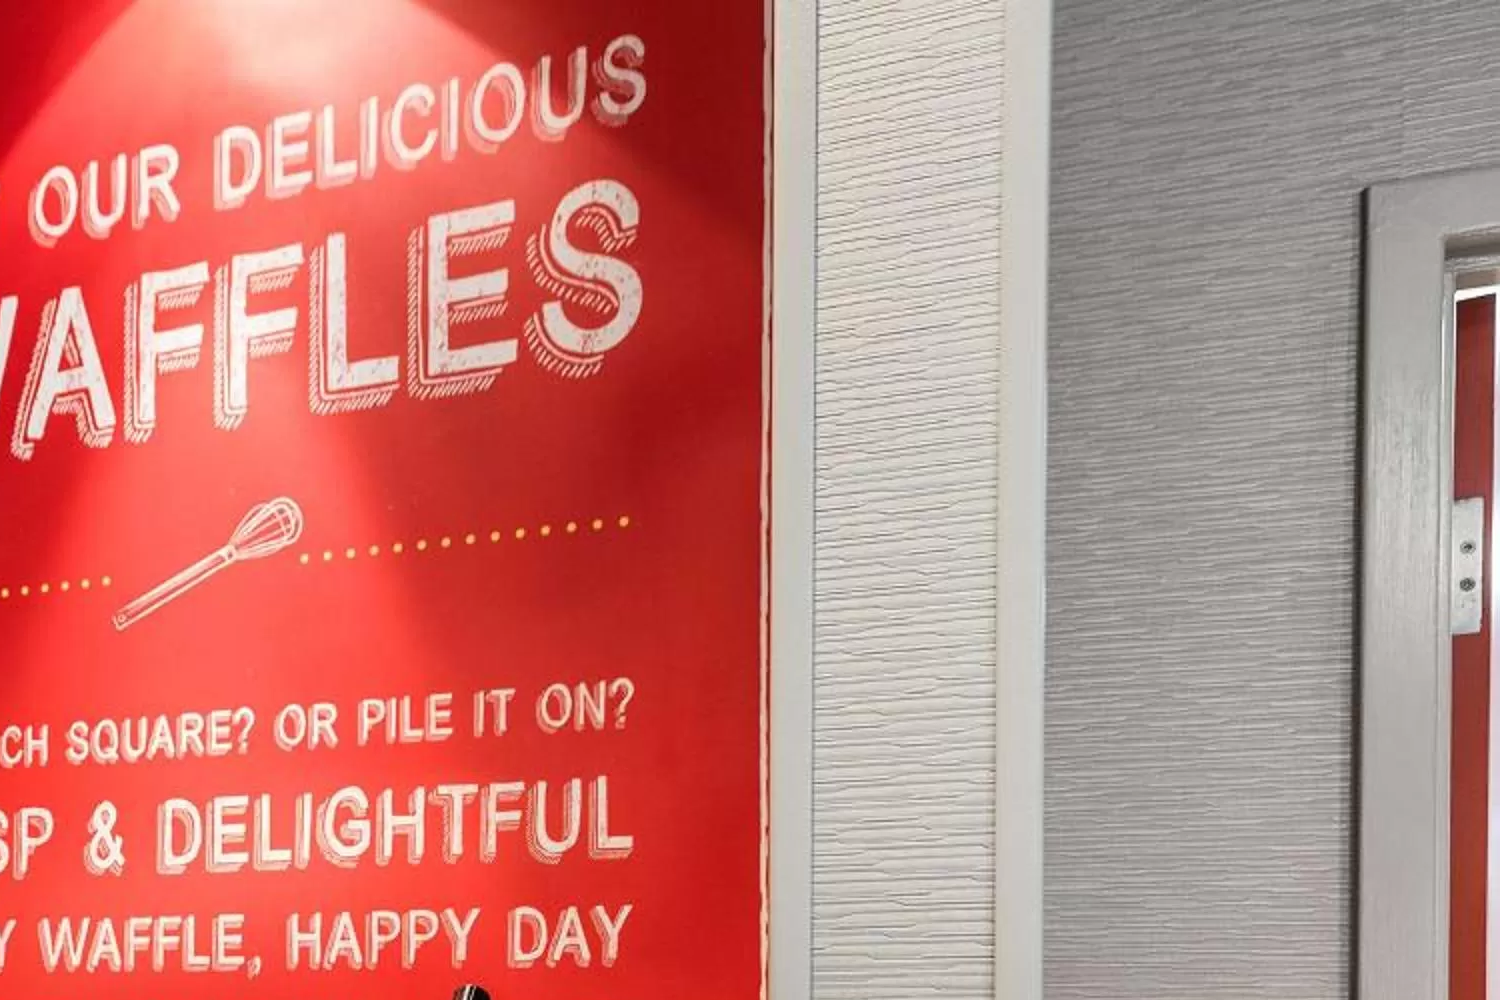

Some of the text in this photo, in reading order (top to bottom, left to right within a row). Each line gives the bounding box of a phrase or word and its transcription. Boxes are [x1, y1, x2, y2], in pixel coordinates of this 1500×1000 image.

[28, 143, 182, 248] OUR
[212, 34, 648, 212] DELICIOUS
[64, 706, 256, 767] SQUARE?
[273, 701, 339, 751] OR
[356, 692, 453, 745] PILE
[472, 687, 516, 737] IT
[536, 676, 637, 734] ON?
[85, 799, 126, 878] &
[156, 774, 634, 876] DELIGHTFUL
[38, 913, 263, 980] WAFFLE,
[287, 907, 482, 971] HAPPY
[506, 903, 634, 968] DAY
